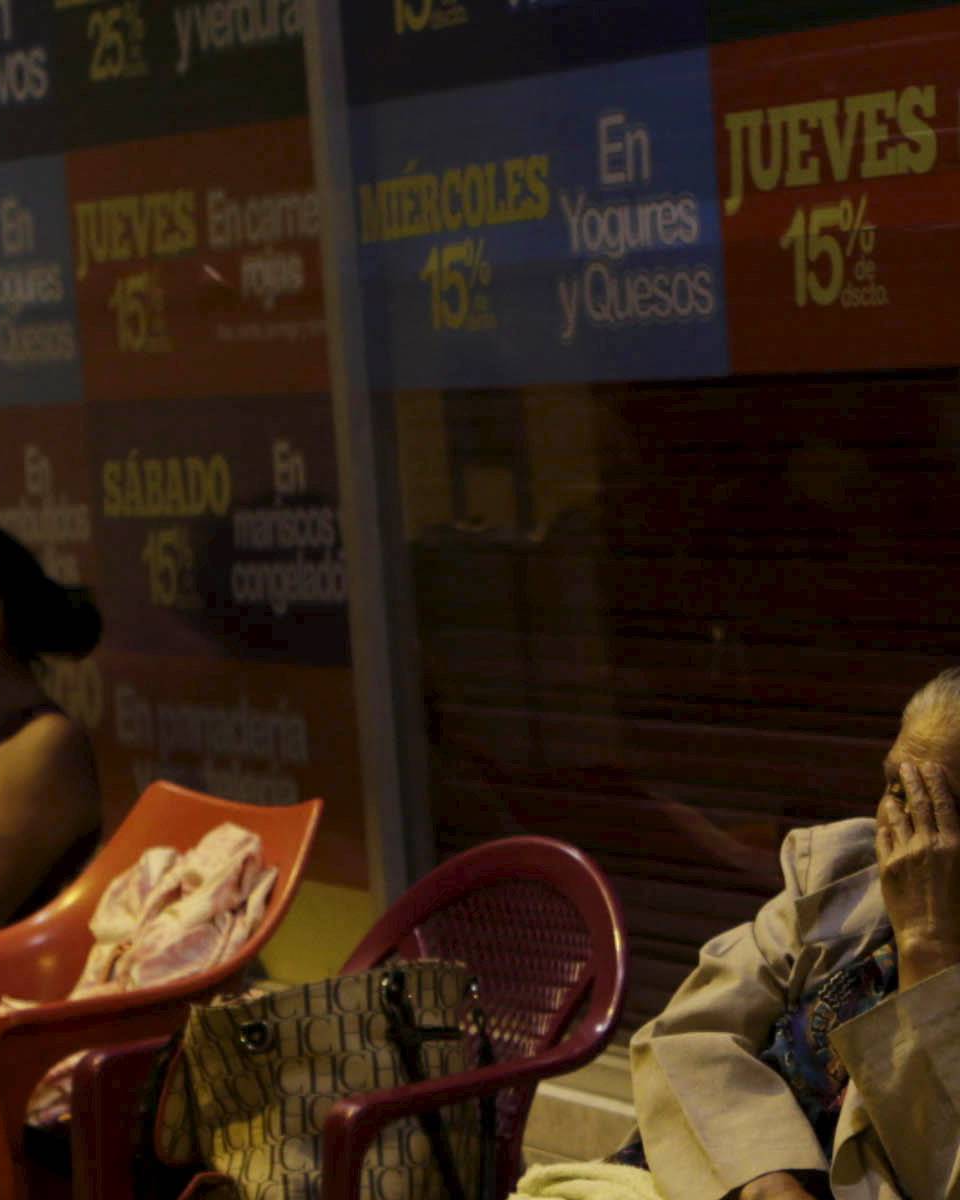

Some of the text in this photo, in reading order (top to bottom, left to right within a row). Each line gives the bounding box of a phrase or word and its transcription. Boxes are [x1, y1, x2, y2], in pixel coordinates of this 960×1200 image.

[597, 110, 652, 187] En
[724, 85, 938, 216] JUEVES
[74, 190, 198, 281] JUEVES
[358, 155, 549, 245] MIÉRCOLES
[559, 192, 700, 257] Yogures
[778, 192, 876, 307] 15%
[103, 449, 231, 518] SÁBADO
